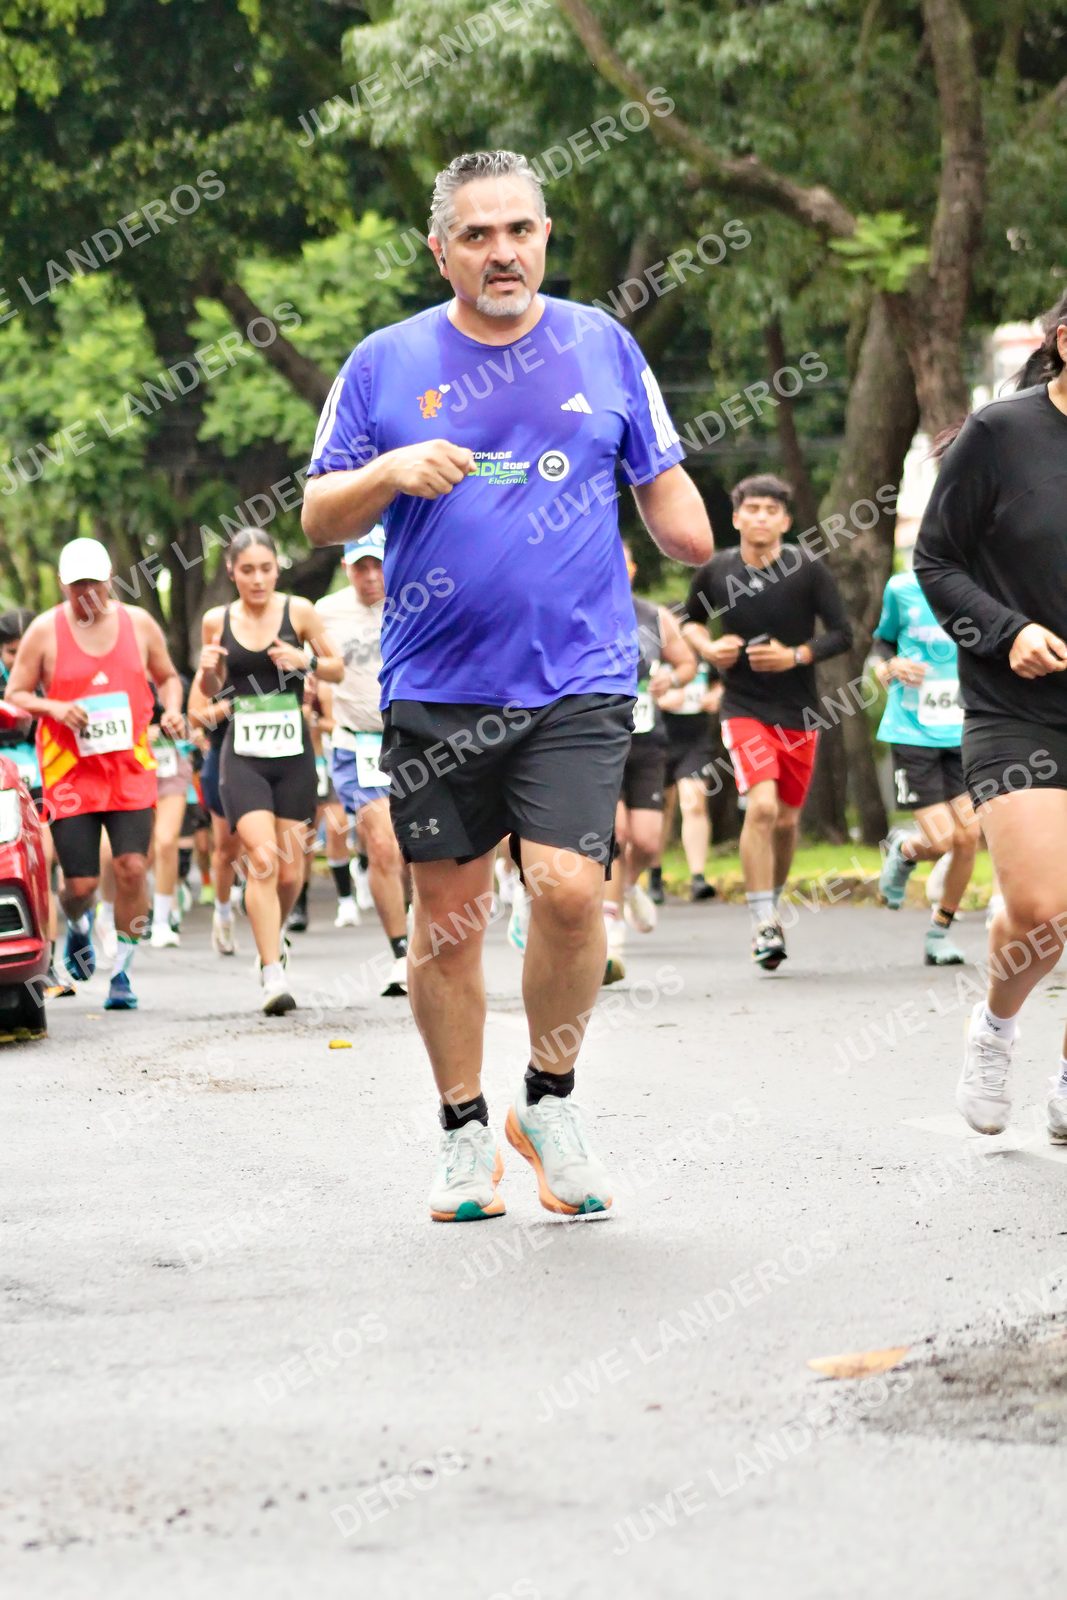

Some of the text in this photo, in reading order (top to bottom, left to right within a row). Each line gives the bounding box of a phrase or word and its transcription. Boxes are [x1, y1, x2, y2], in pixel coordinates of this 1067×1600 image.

[488, 477, 528, 485] Electrolit
[924, 692, 957, 710] 46
[242, 723, 295, 742] 1770
